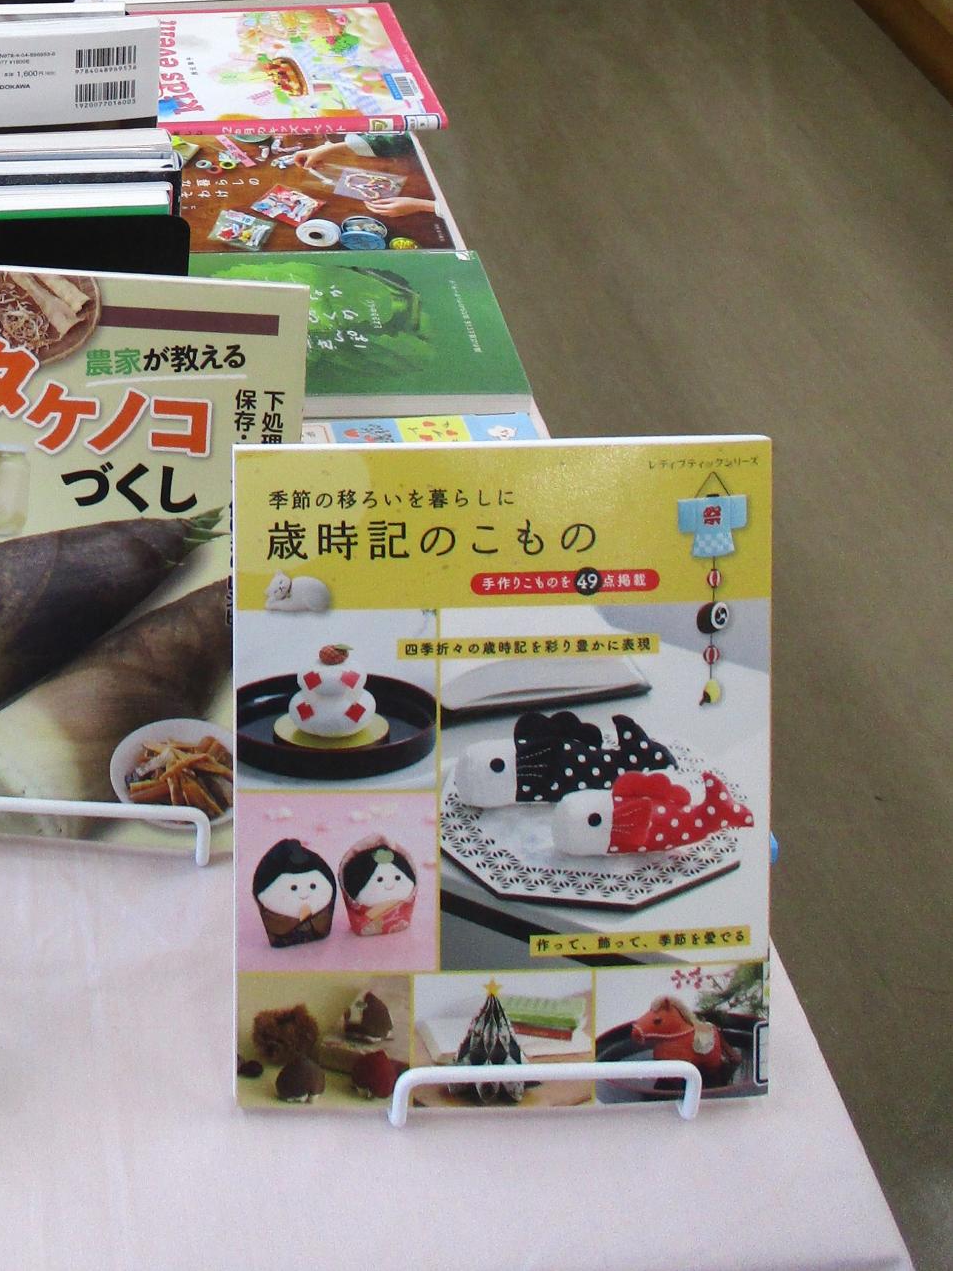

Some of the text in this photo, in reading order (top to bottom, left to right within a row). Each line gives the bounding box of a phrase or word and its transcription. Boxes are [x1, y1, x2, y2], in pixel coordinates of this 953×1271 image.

[85, 343, 247, 377] 農家が教える
[61, 462, 198, 514] づくし
[268, 488, 515, 511] 季節の移ろいを暮らしに
[267, 519, 598, 562] 歳時記のこもの
[482, 566, 648, 593] 手作りこものを49点掲載
[404, 637, 652, 656] 四季折々の歳時記を彩り豊かに表現
[536, 929, 746, 953] 作って、飾って、季節を愛でる
